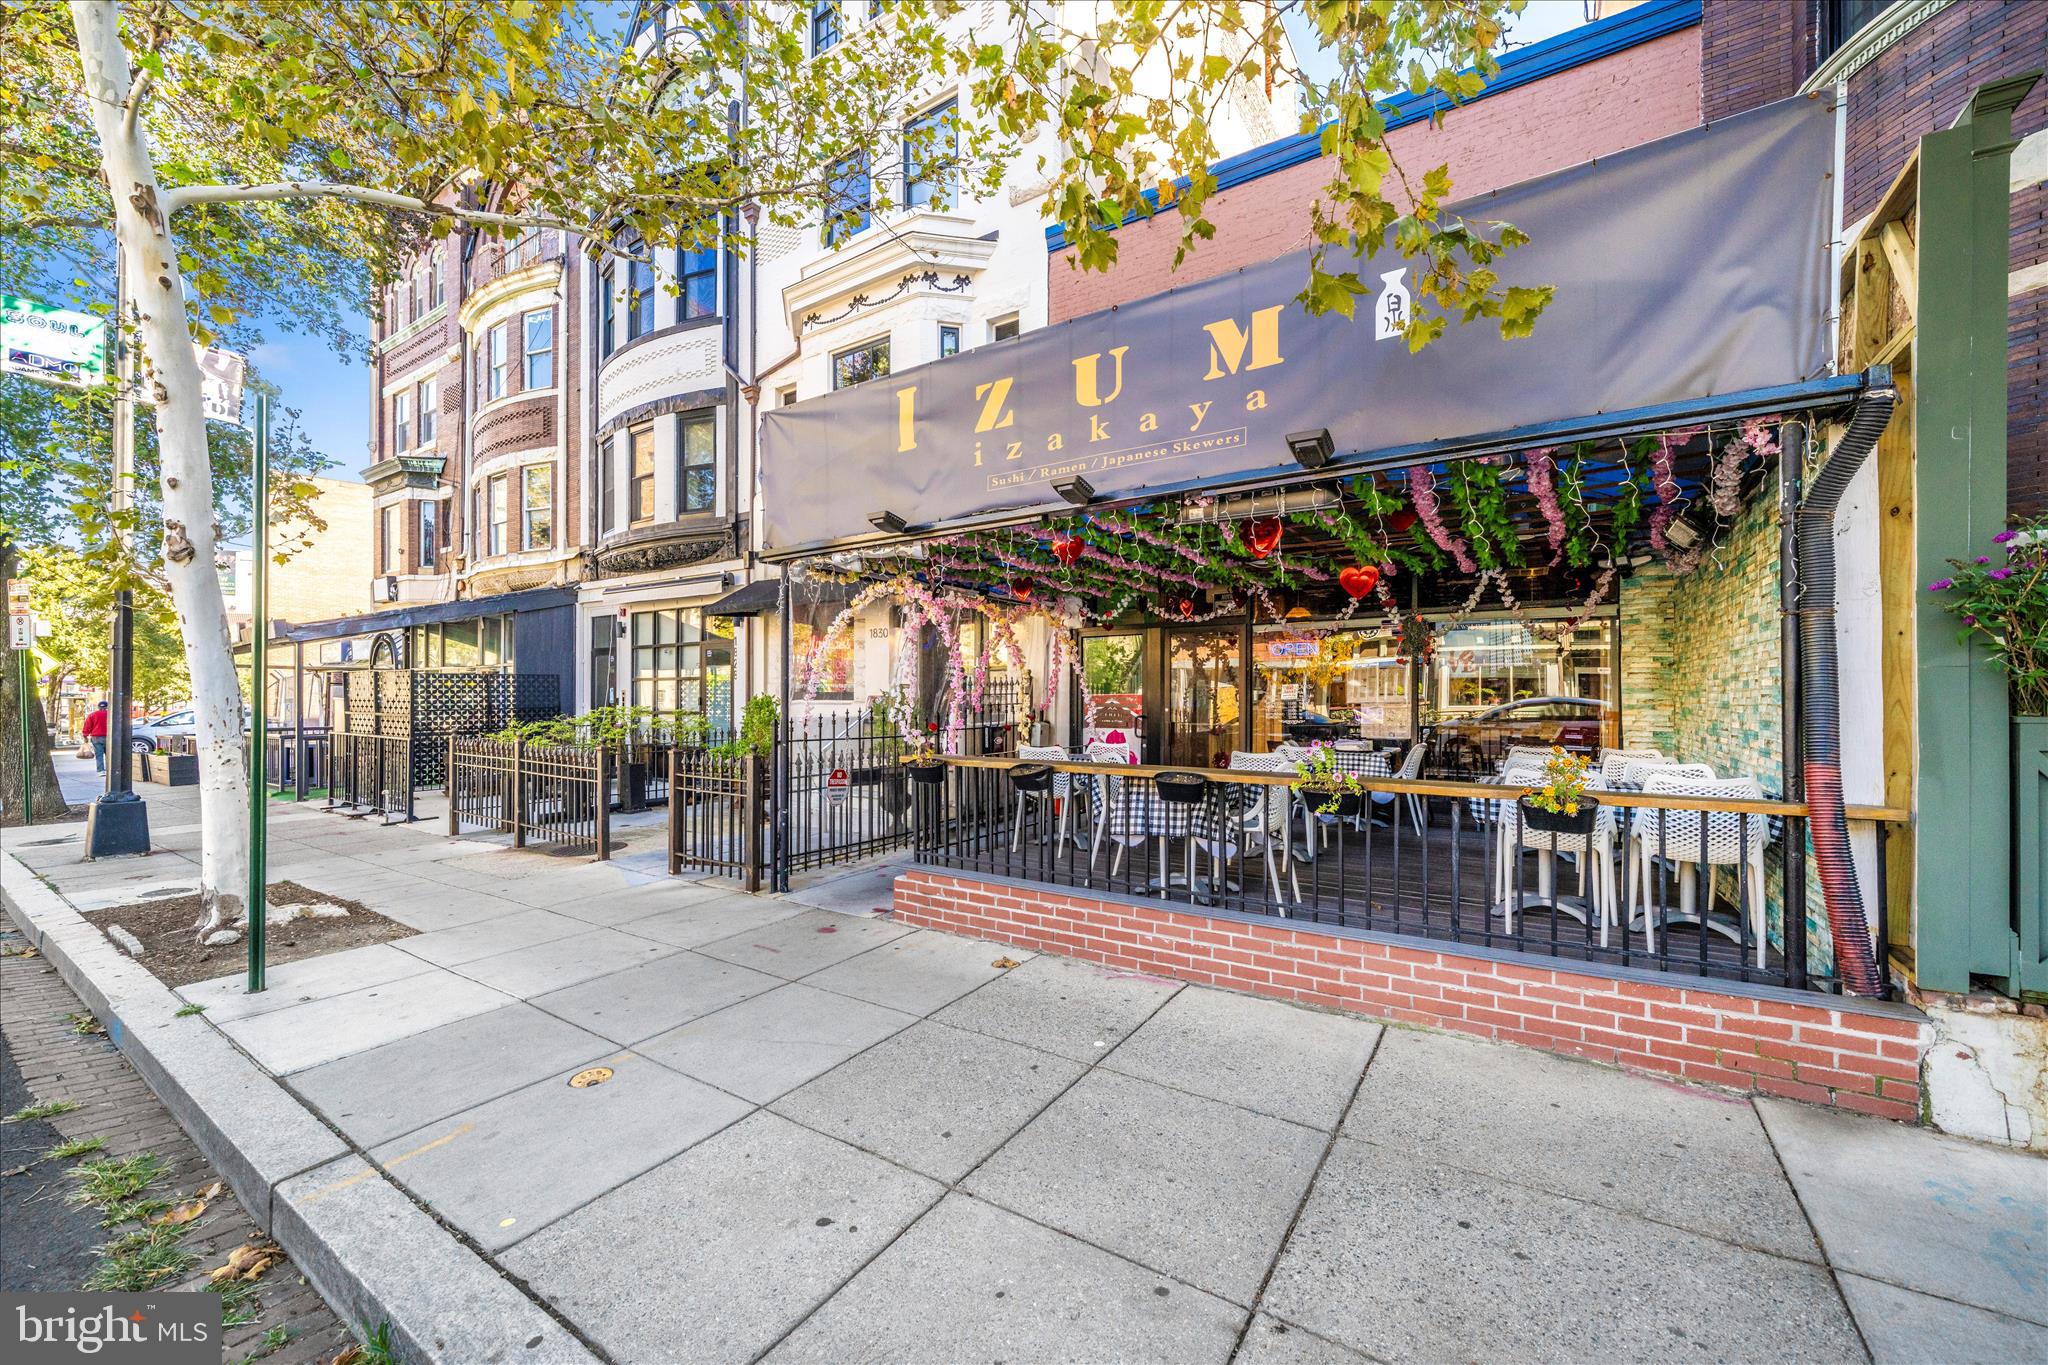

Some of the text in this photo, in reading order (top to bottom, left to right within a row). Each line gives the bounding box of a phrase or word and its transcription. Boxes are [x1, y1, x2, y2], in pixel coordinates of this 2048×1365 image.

[973, 389, 1268, 467] izakaya
[991, 472, 1024, 487] Sushi
[1040, 461, 1087, 478] Ramen
[1102, 446, 1168, 469] Japanese
[1172, 433, 1241, 454] Skewers
[870, 627, 889, 639] 1830
[1271, 642, 1318, 656] OPEN
